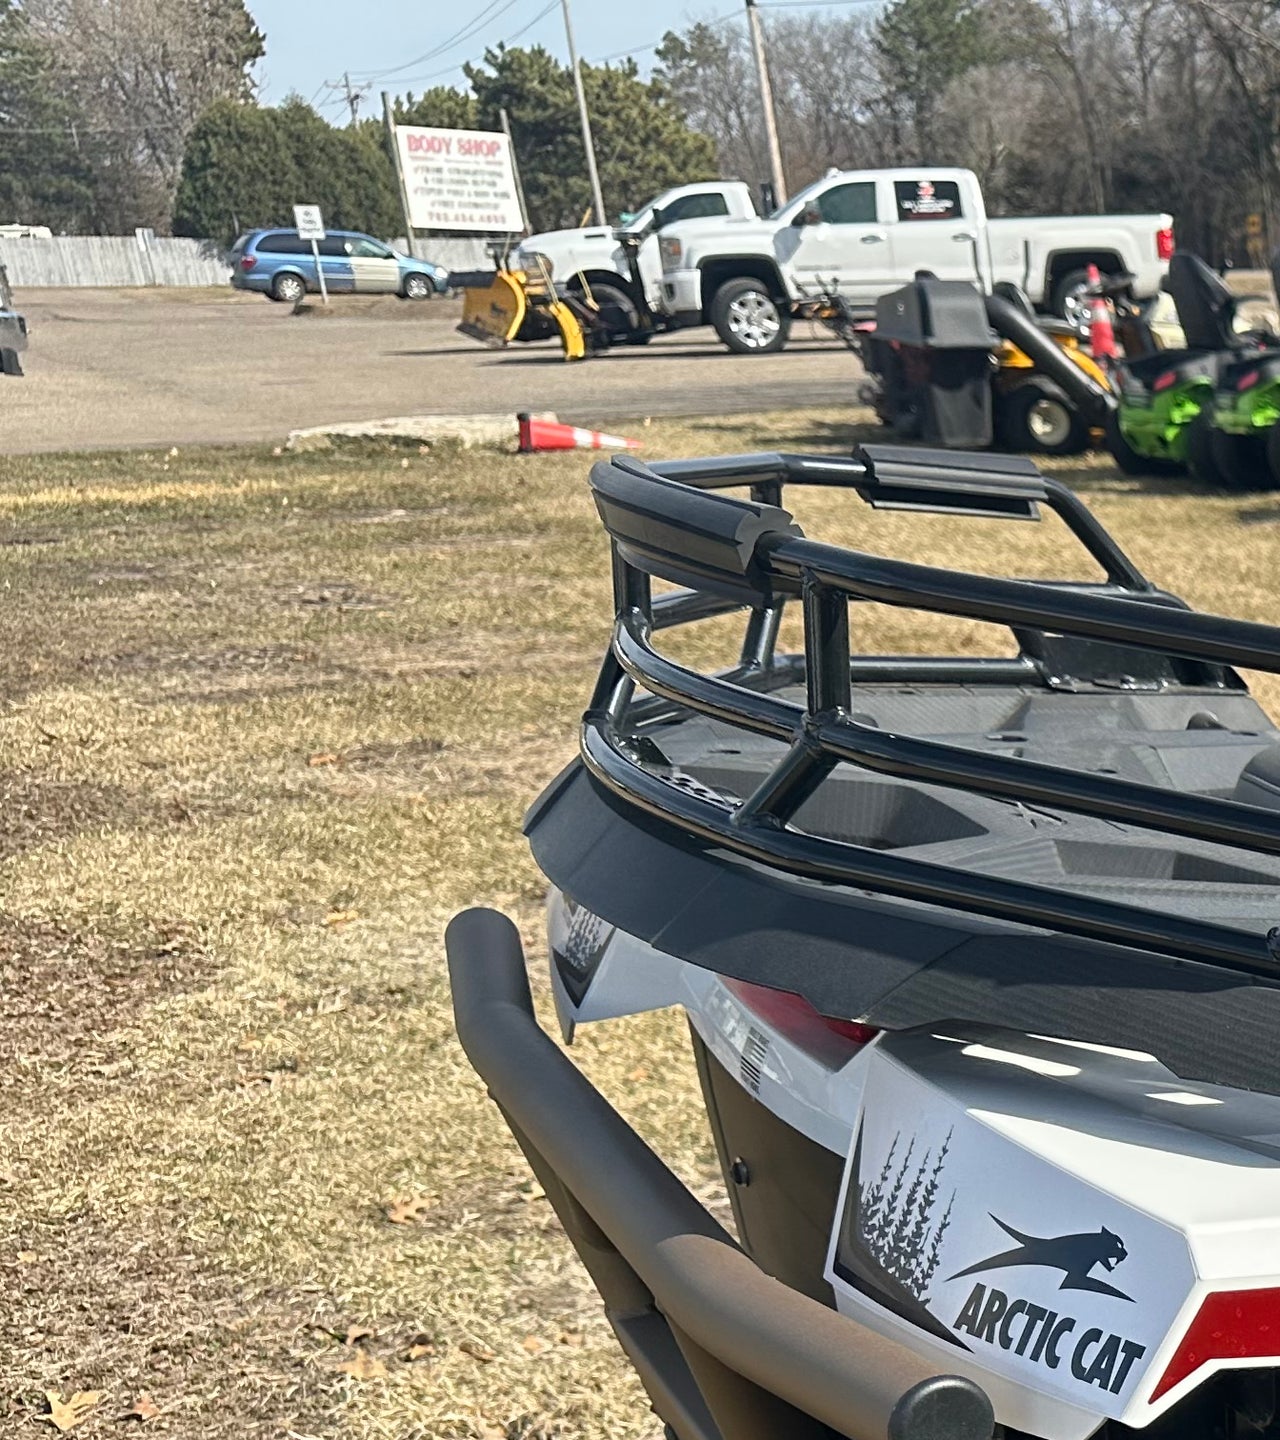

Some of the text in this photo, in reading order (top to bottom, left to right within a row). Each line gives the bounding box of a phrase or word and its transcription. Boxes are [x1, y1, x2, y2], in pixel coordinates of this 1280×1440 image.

[406, 133, 501, 157] BODY SHOP
[952, 1282, 1147, 1395] ARCTIC CAT
